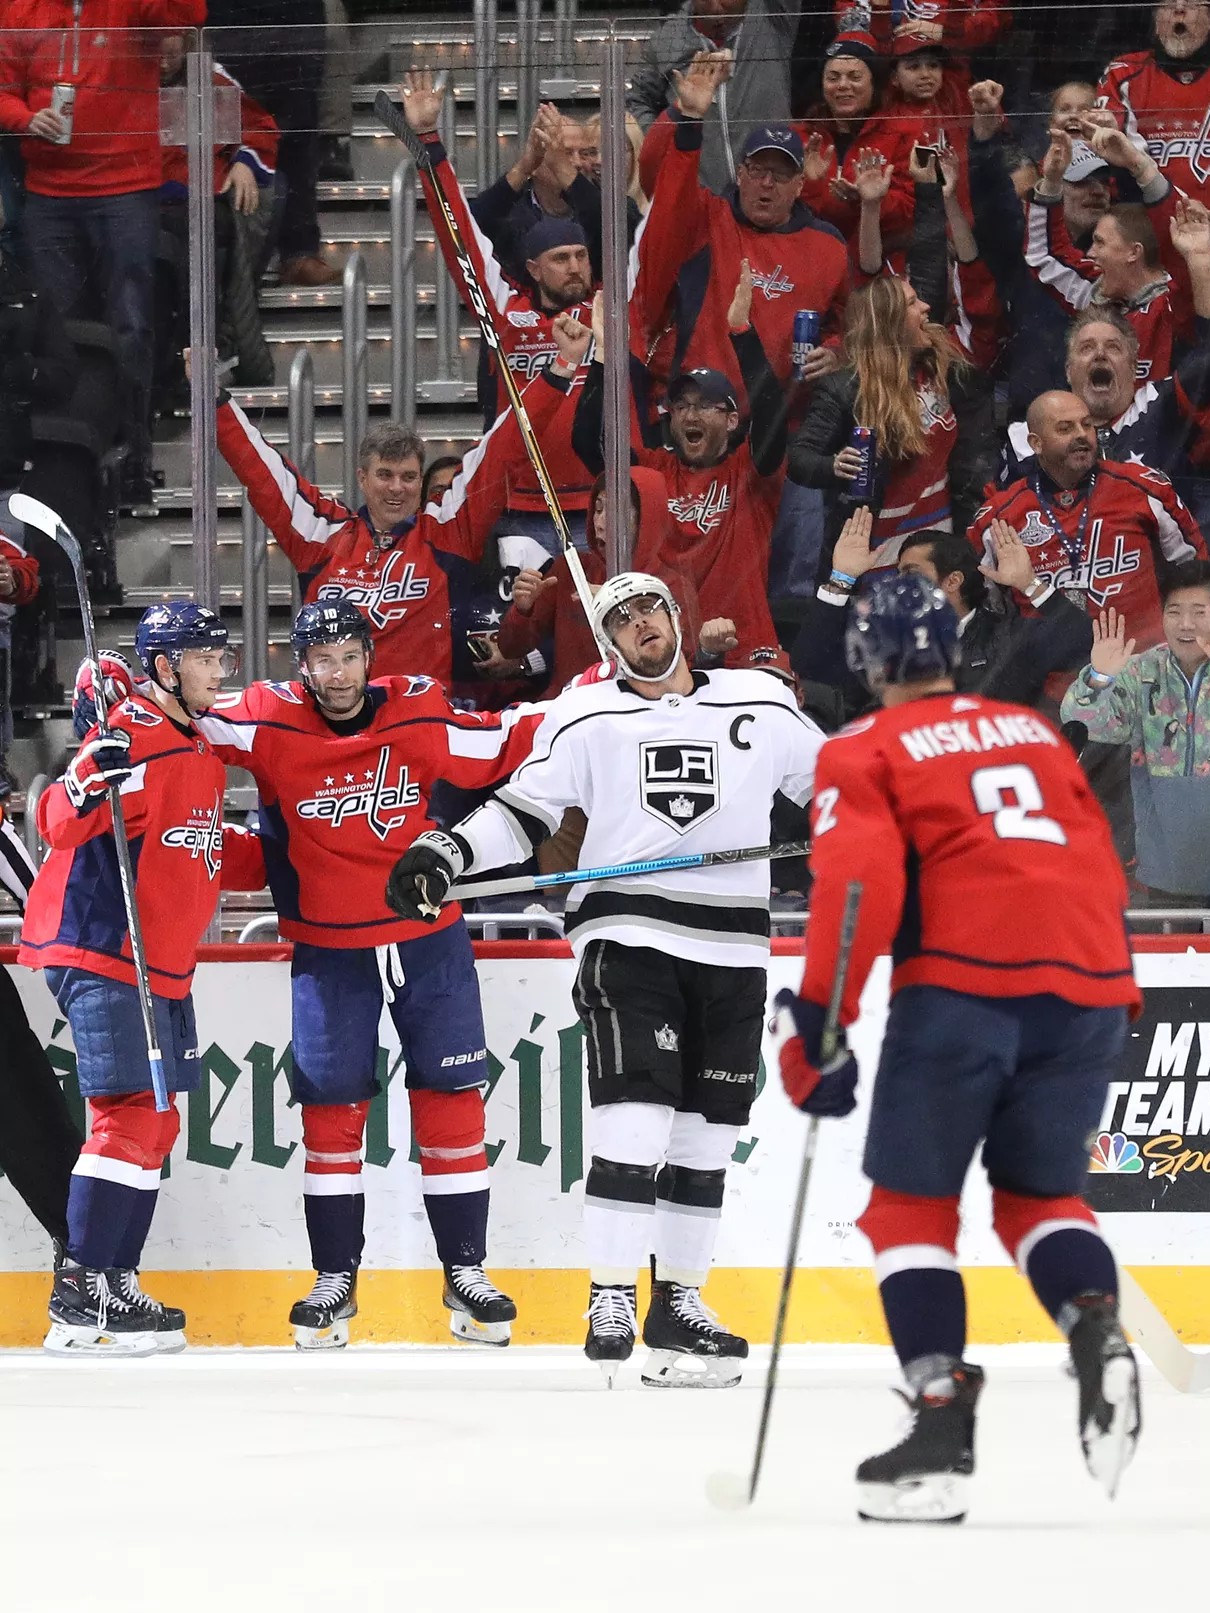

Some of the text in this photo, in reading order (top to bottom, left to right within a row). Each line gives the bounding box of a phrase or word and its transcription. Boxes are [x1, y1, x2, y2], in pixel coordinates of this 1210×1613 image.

[456, 254, 500, 349] CCM
[514, 342, 558, 351] WASHINGTO
[1034, 555, 1088, 573] WASHINGN
[1035, 519, 1141, 608] apitals
[323, 608, 338, 620] 10
[729, 713, 756, 751] C
[645, 749, 715, 784] LA
[296, 746, 420, 842] capitals
[315, 782, 374, 798] WASHINGTON
[970, 763, 1068, 847] 2
[814, 787, 840, 837] 2
[828, 1221, 854, 1229] DRIN
